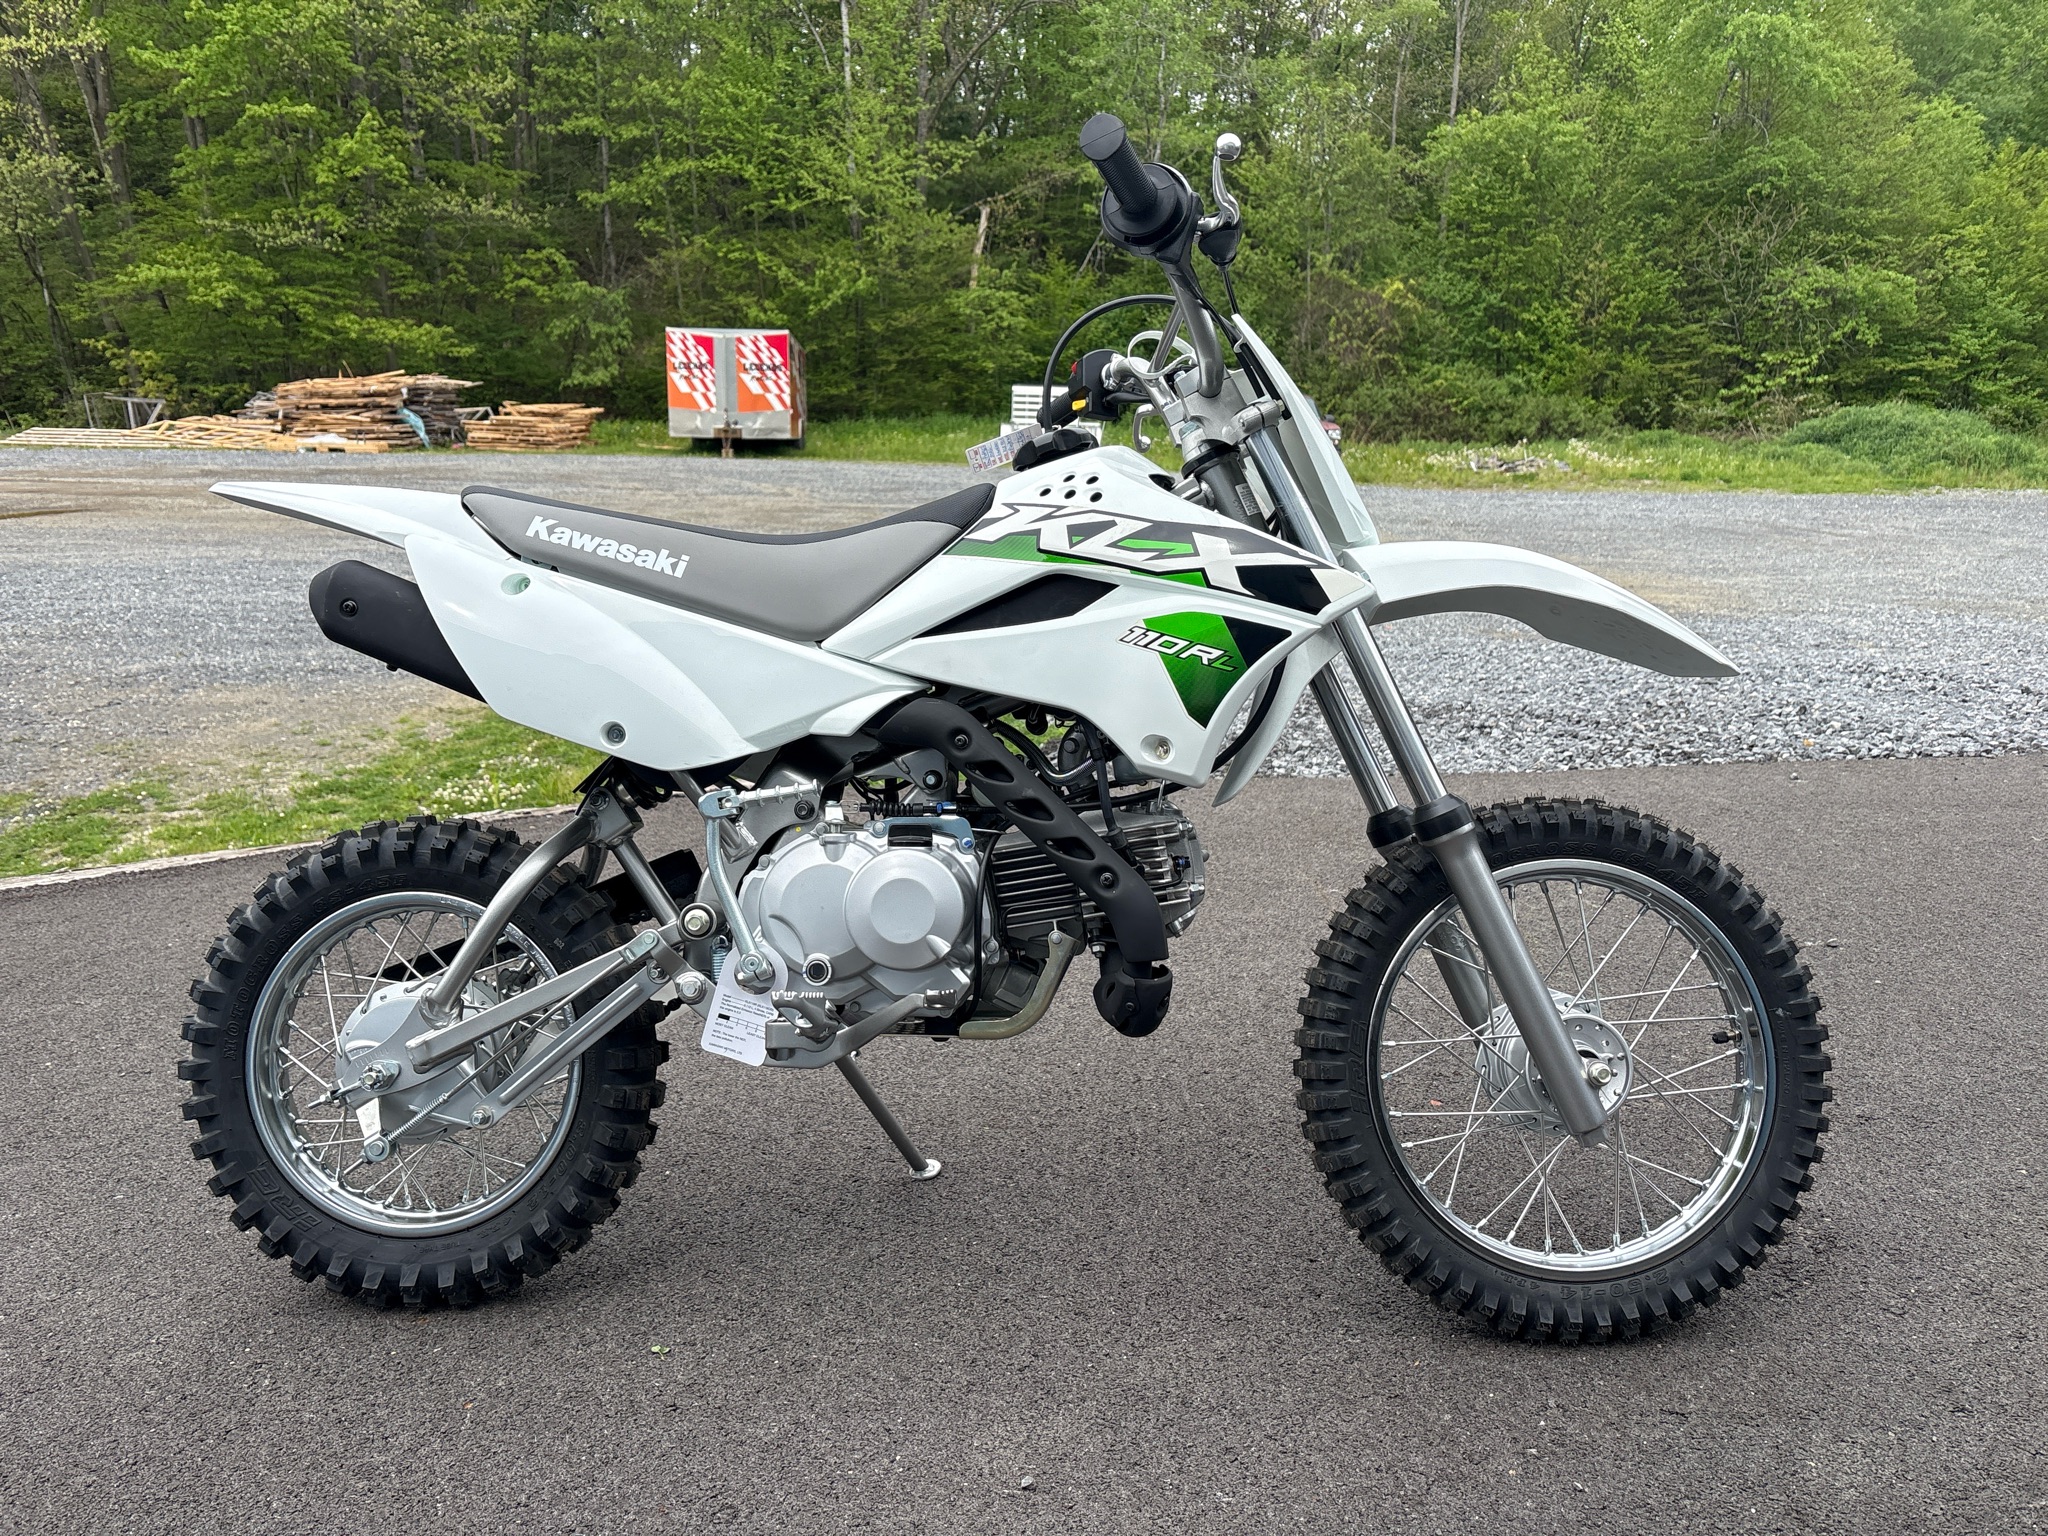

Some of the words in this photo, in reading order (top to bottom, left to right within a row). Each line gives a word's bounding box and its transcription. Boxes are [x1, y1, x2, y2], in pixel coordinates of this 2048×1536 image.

[525, 515, 691, 579] Kawasaki
[963, 502, 1322, 598] KLX
[223, 914, 303, 1060] MOTOCROSS
[1559, 1267, 1670, 1300] 2.50-14
